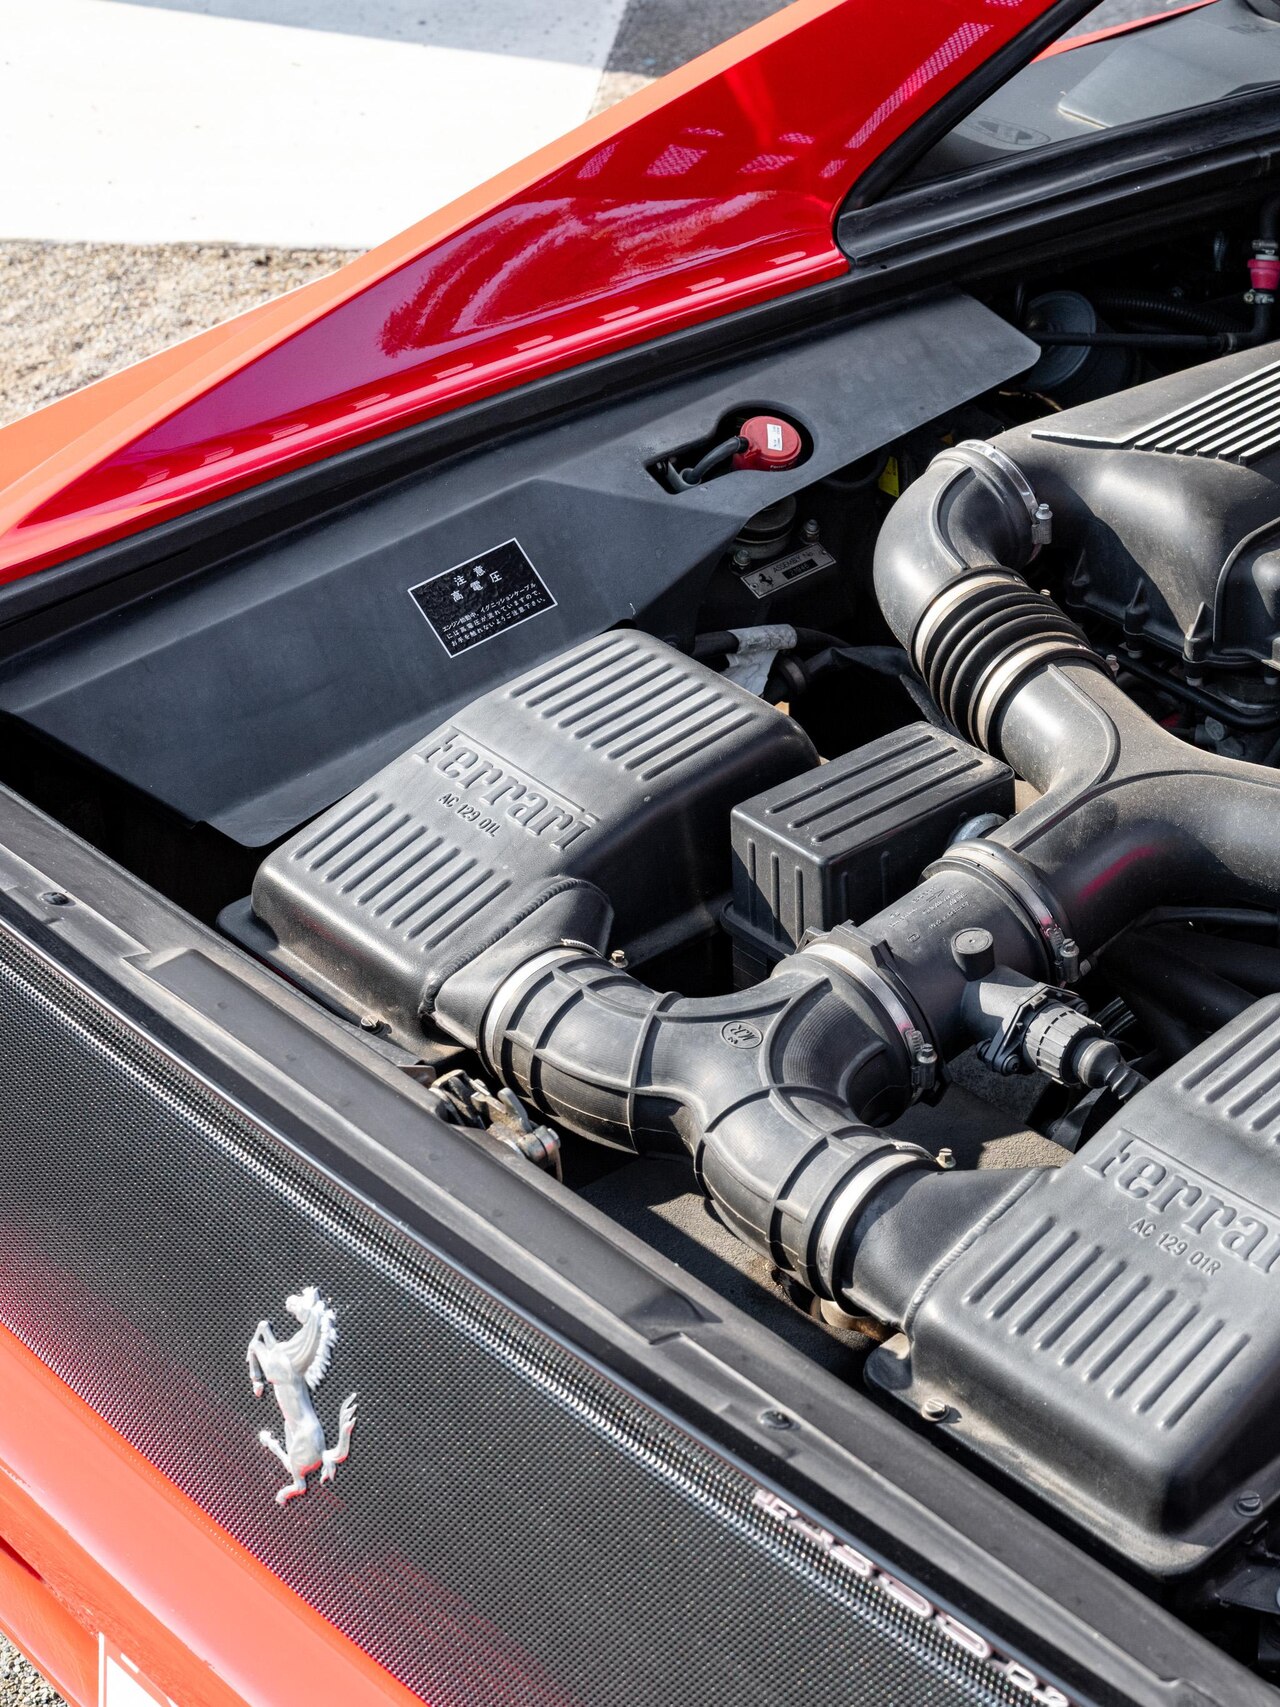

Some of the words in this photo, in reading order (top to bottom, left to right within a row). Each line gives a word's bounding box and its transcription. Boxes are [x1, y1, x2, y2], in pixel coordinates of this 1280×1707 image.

[453, 564, 486, 587] 注意
[772, 554, 801, 574] ASSEMBLY
[451, 570, 503, 603] 高電圧
[413, 725, 600, 852] Ferrari
[438, 793, 459, 808] AC
[456, 803, 481, 822] 129
[1128, 1218, 1157, 1238] AC
[1157, 1232, 1188, 1256] 129
